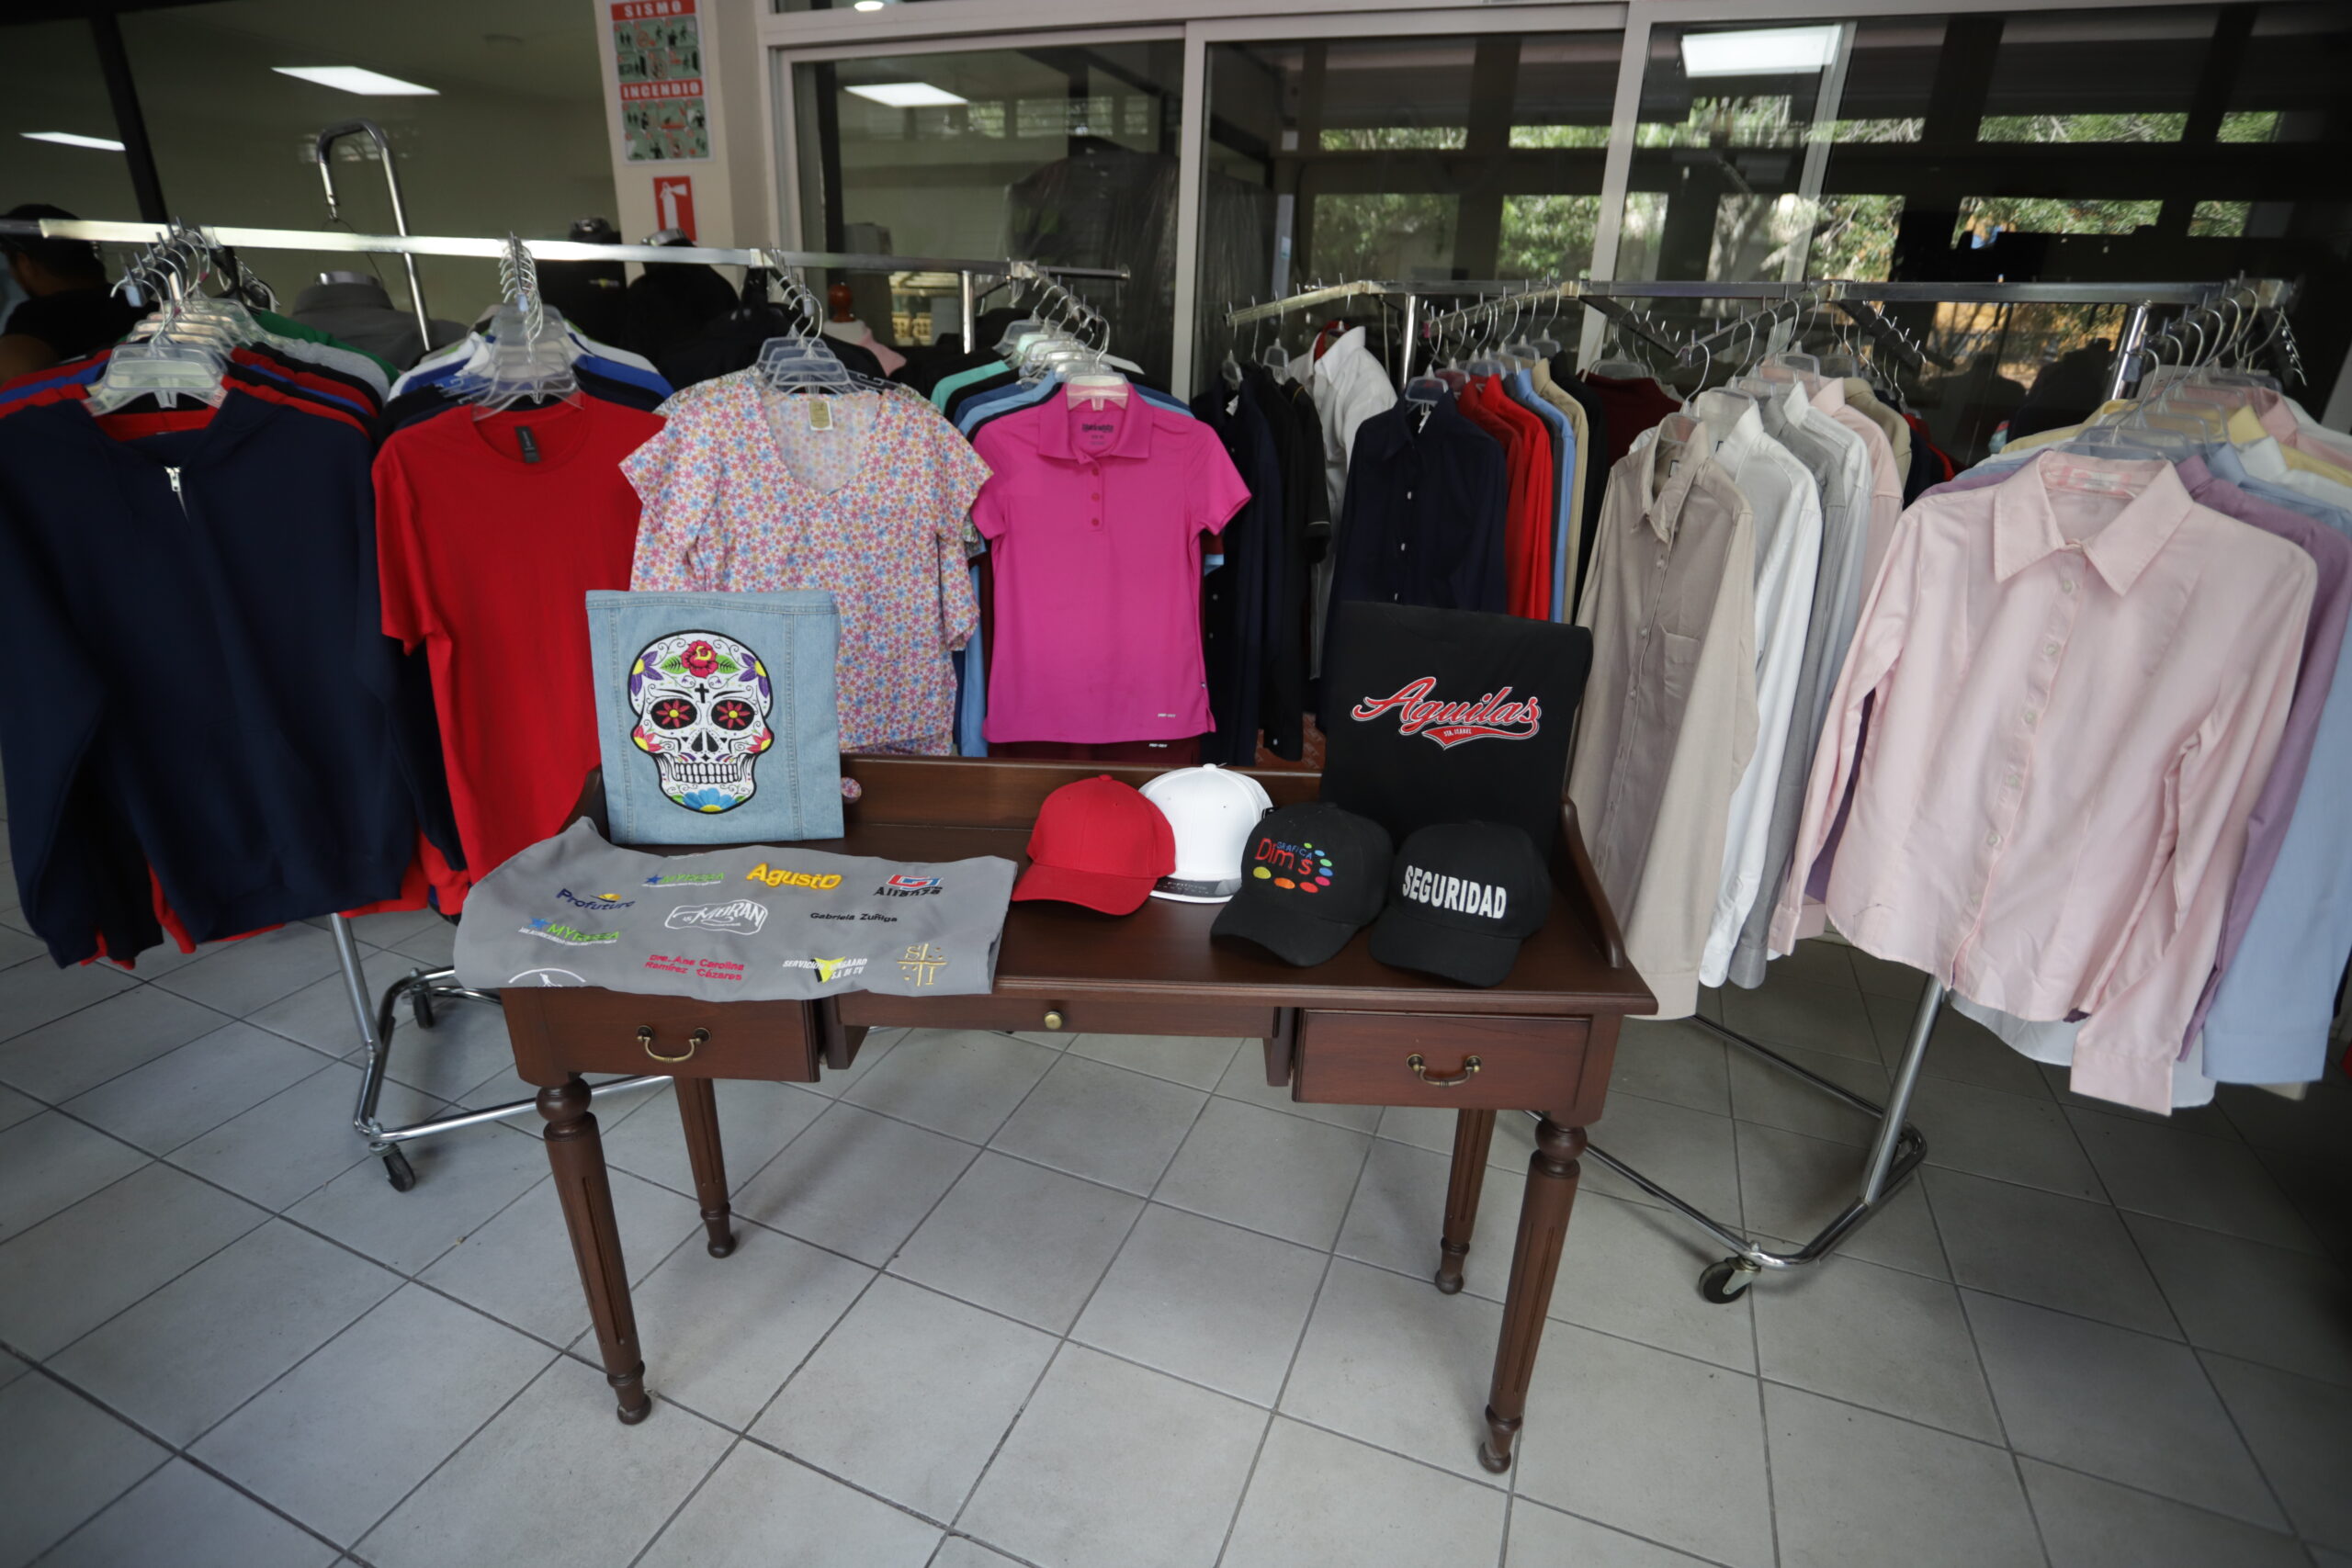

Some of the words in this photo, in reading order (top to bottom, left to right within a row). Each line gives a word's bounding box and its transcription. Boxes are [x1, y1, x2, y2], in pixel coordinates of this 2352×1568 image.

[624, 1, 682, 17] SISMO
[623, 81, 700, 98] INCENDIO
[1351, 676, 1542, 736] Aguilas
[746, 863, 842, 889] Agusto
[556, 888, 635, 910] Profuturo
[1402, 865, 1507, 919] SEGURIDAD
[810, 912, 855, 920] Gabriela
[645, 962, 688, 974] Ramírez
[696, 968, 741, 981] Cázares
[699, 959, 744, 971] Carolina
